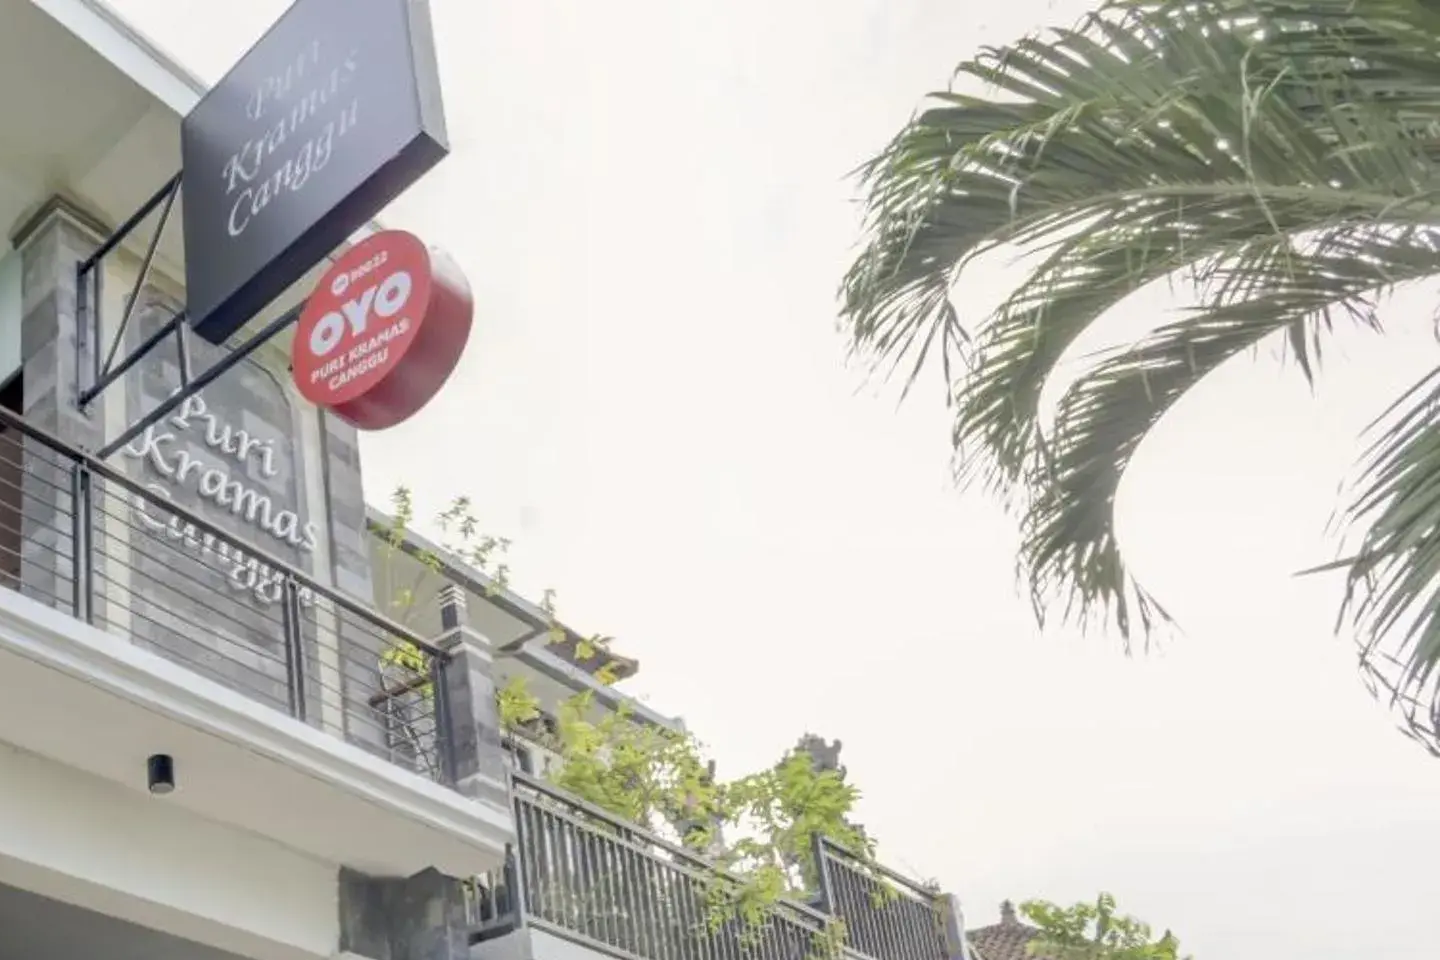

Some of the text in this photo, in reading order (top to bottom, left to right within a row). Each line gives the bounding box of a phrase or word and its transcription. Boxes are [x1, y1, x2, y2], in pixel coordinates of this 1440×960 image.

[222, 48, 359, 194] Kramas
[245, 38, 320, 121] Puri
[227, 98, 359, 237] Canggu
[309, 270, 412, 357] OYO
[310, 316, 411, 384] PURI KRAMAS
[328, 346, 390, 391] CANGGU
[171, 385, 278, 478] Puri
[123, 421, 320, 551] Kramas
